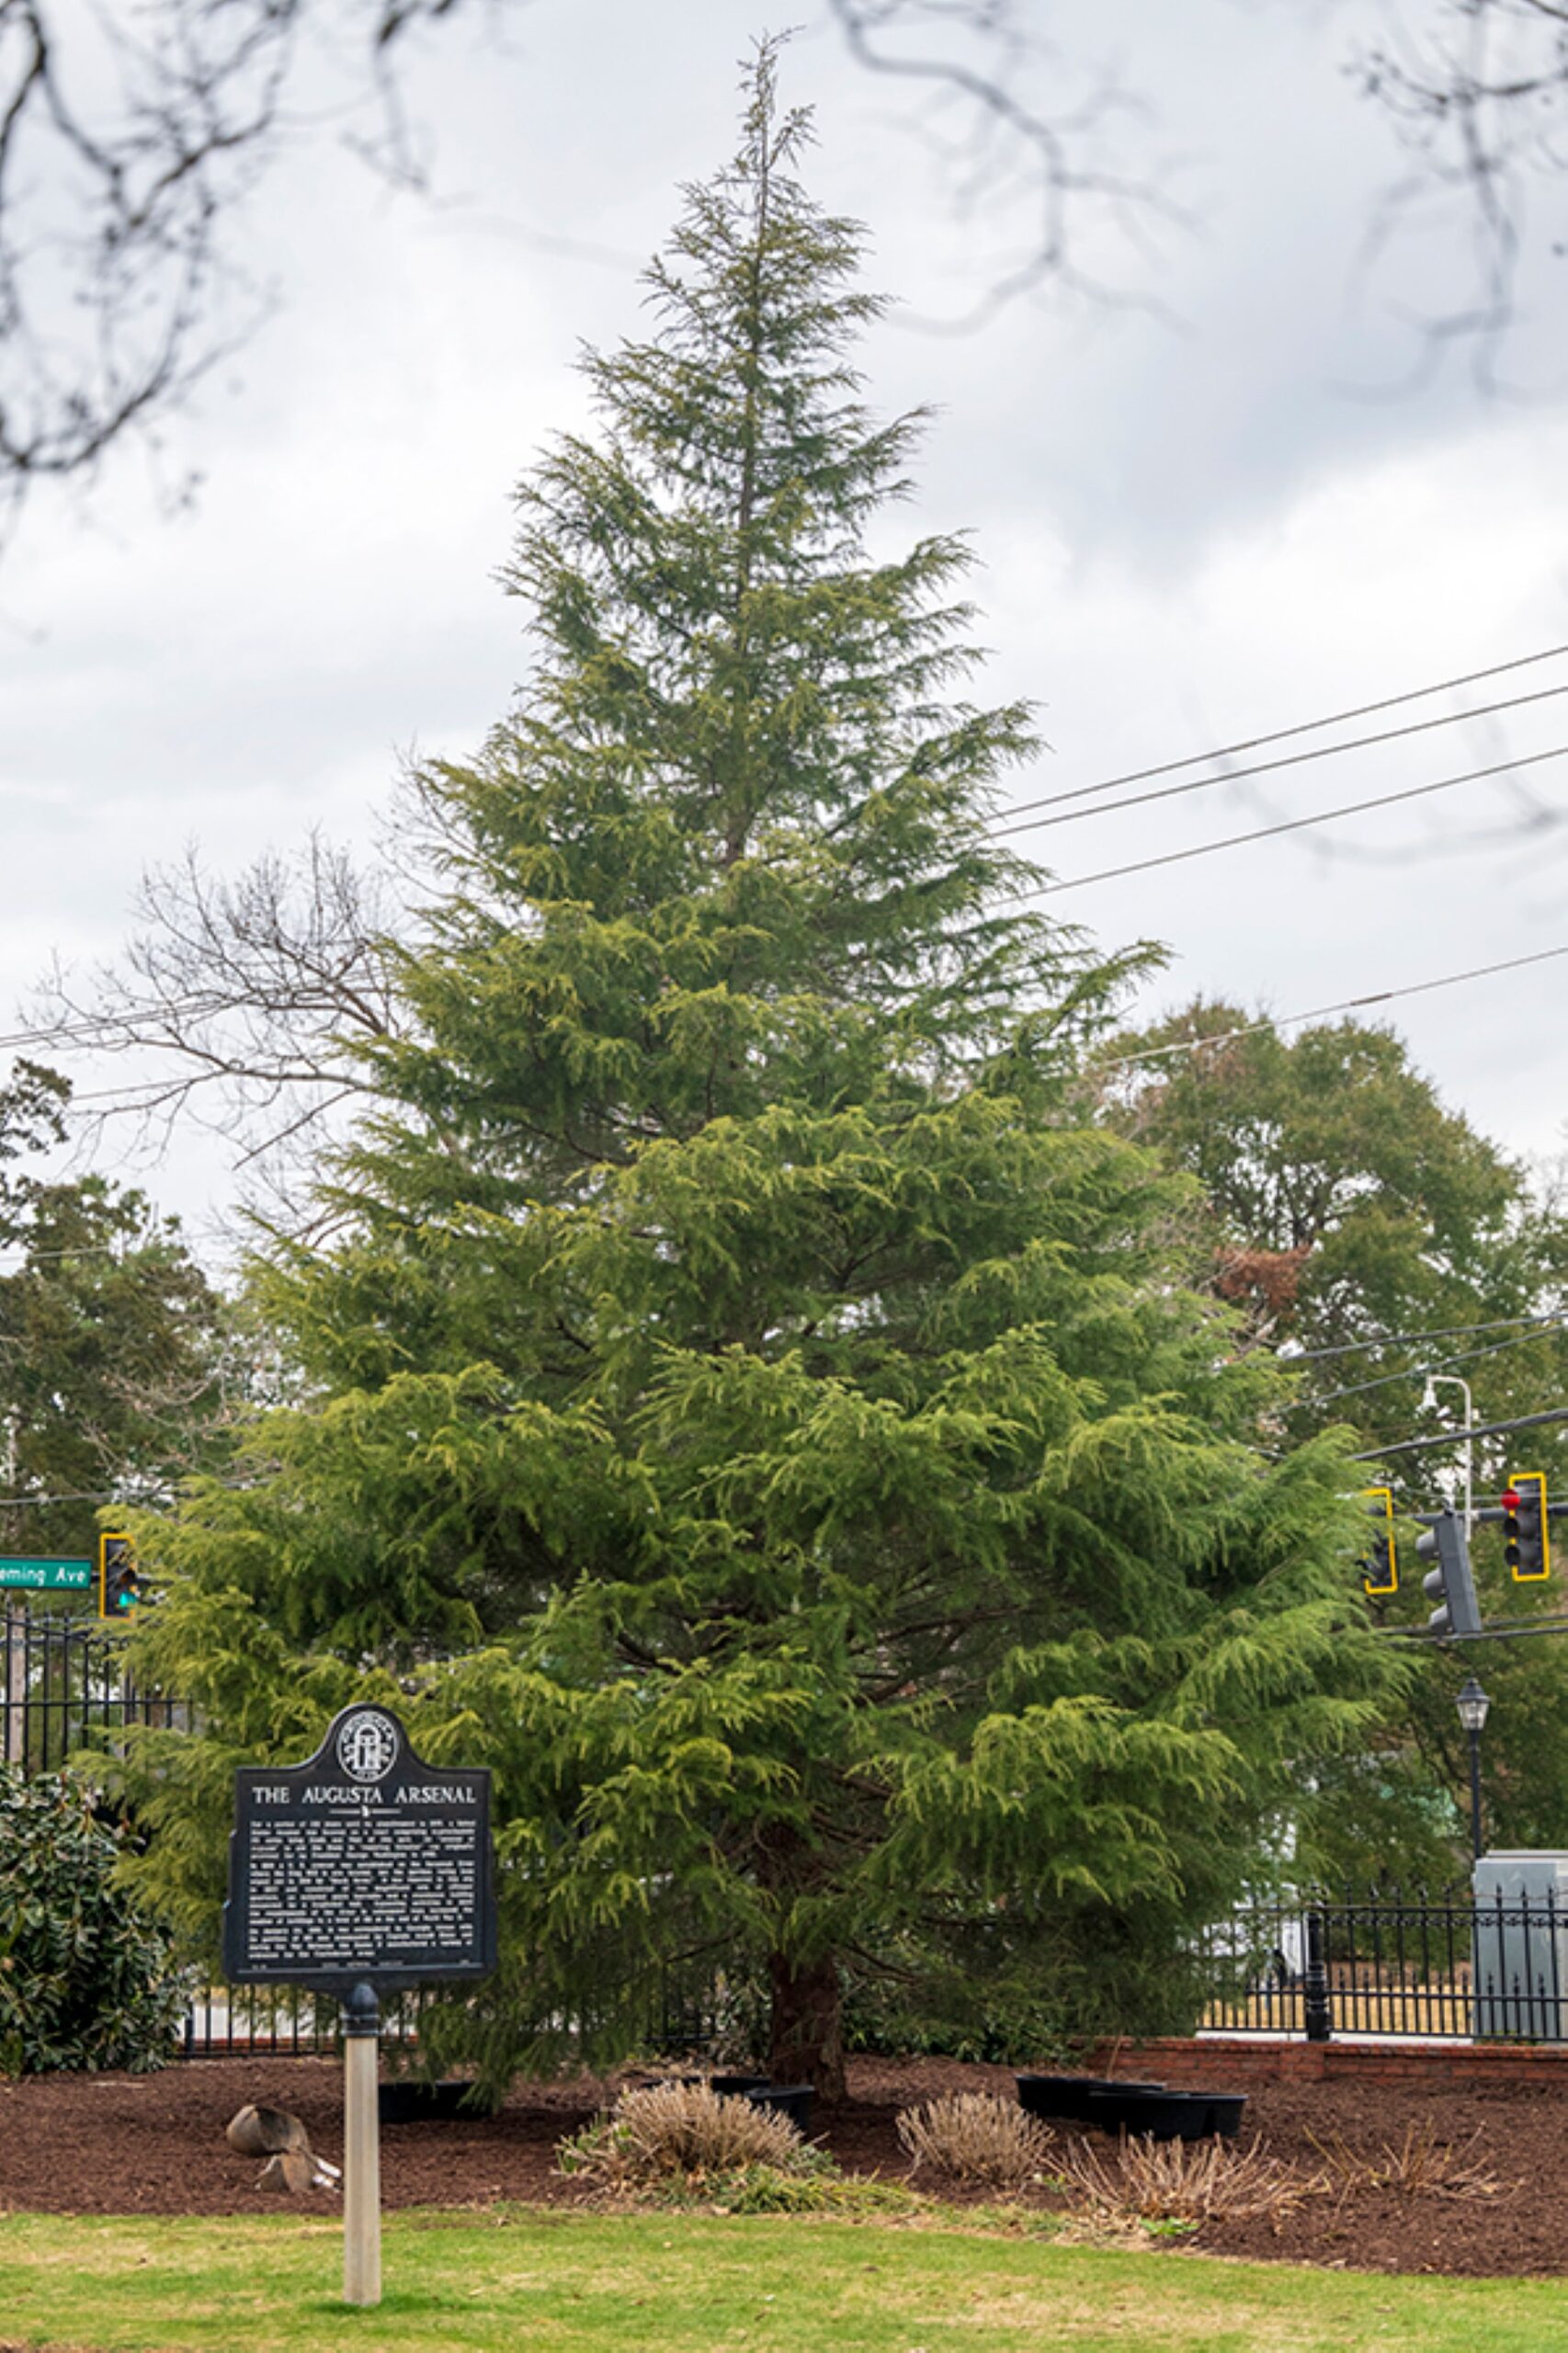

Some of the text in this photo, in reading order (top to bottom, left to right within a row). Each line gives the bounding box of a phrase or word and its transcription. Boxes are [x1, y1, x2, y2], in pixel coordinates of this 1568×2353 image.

[55, 1567, 85, 1583] Ave
[252, 1786, 476, 1803] THE AUGUSTA ARSENAL
